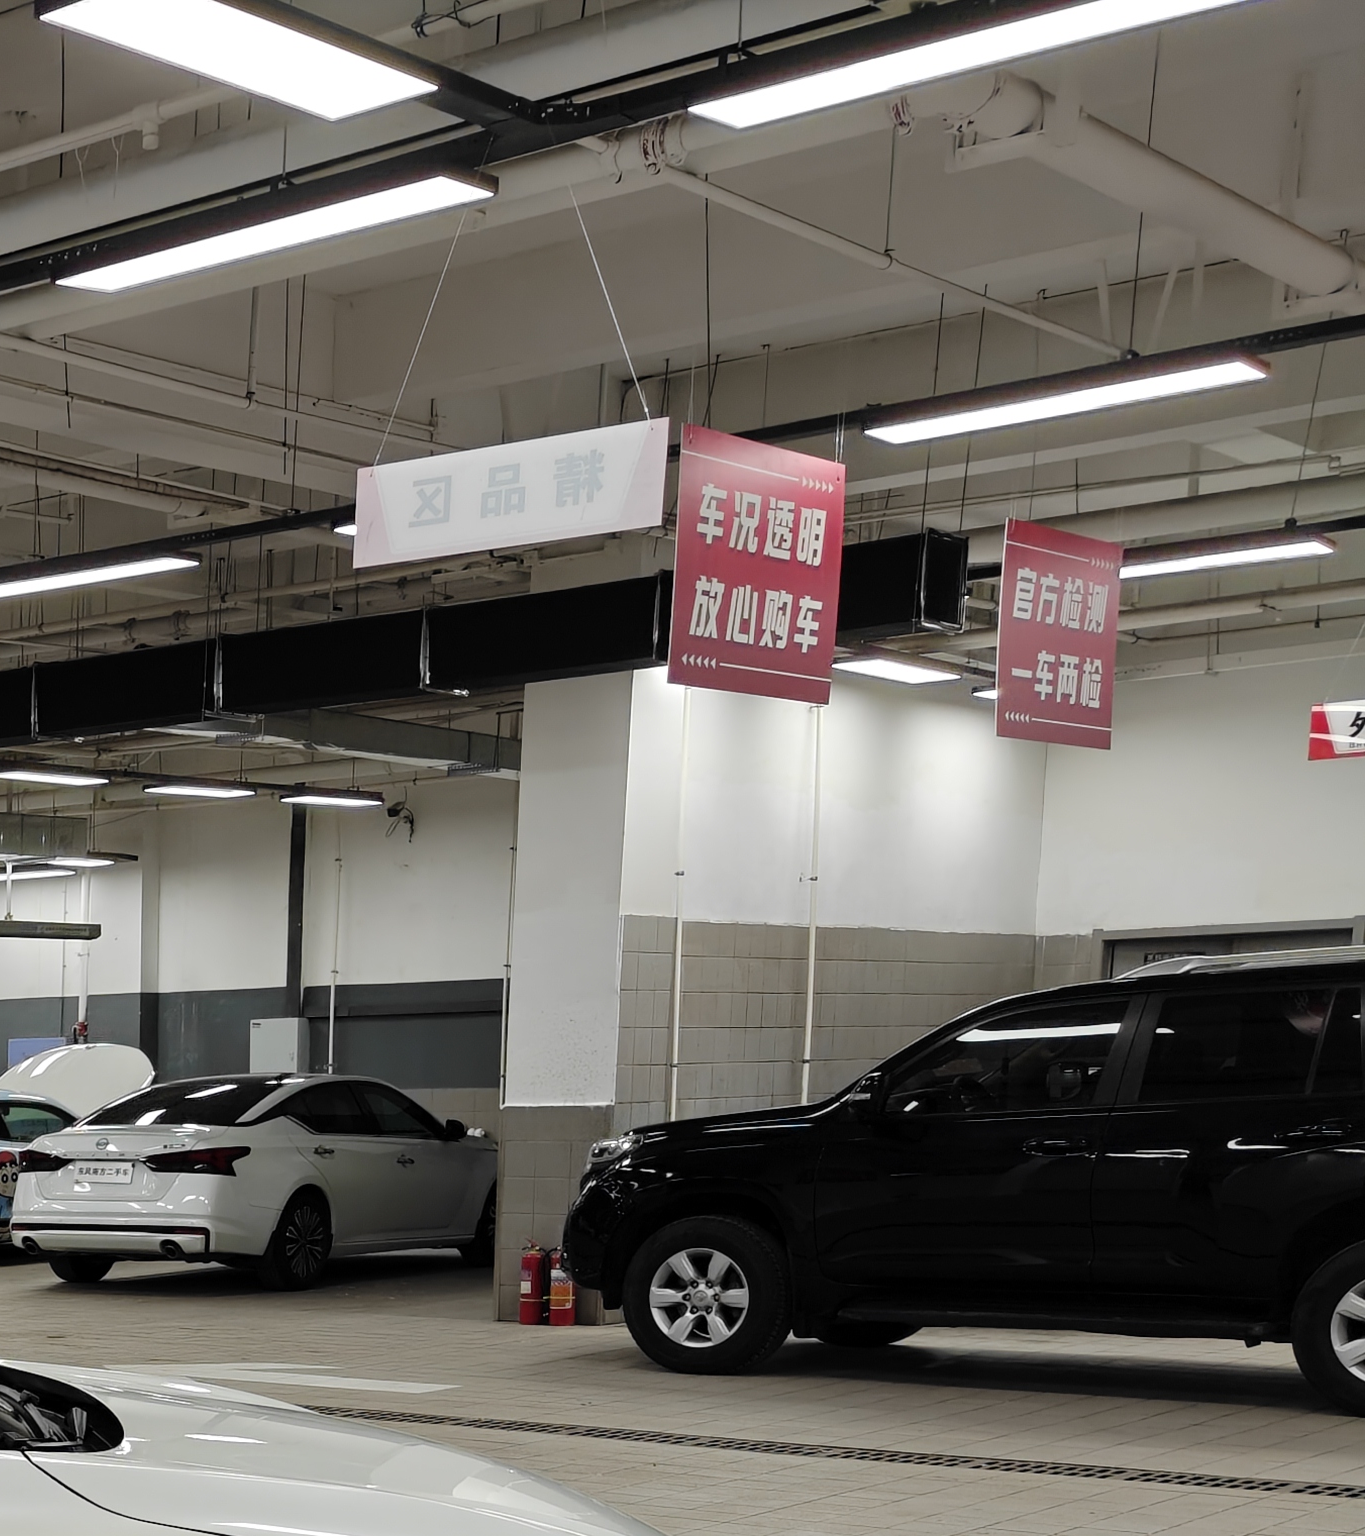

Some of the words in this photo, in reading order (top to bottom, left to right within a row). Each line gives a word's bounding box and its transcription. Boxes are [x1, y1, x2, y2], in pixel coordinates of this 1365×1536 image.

[696, 483, 828, 568] 车况透明
[689, 575, 823, 654] 放心购车
[1012, 567, 1109, 634] 官方检测
[1011, 650, 1103, 709] 一车两检
